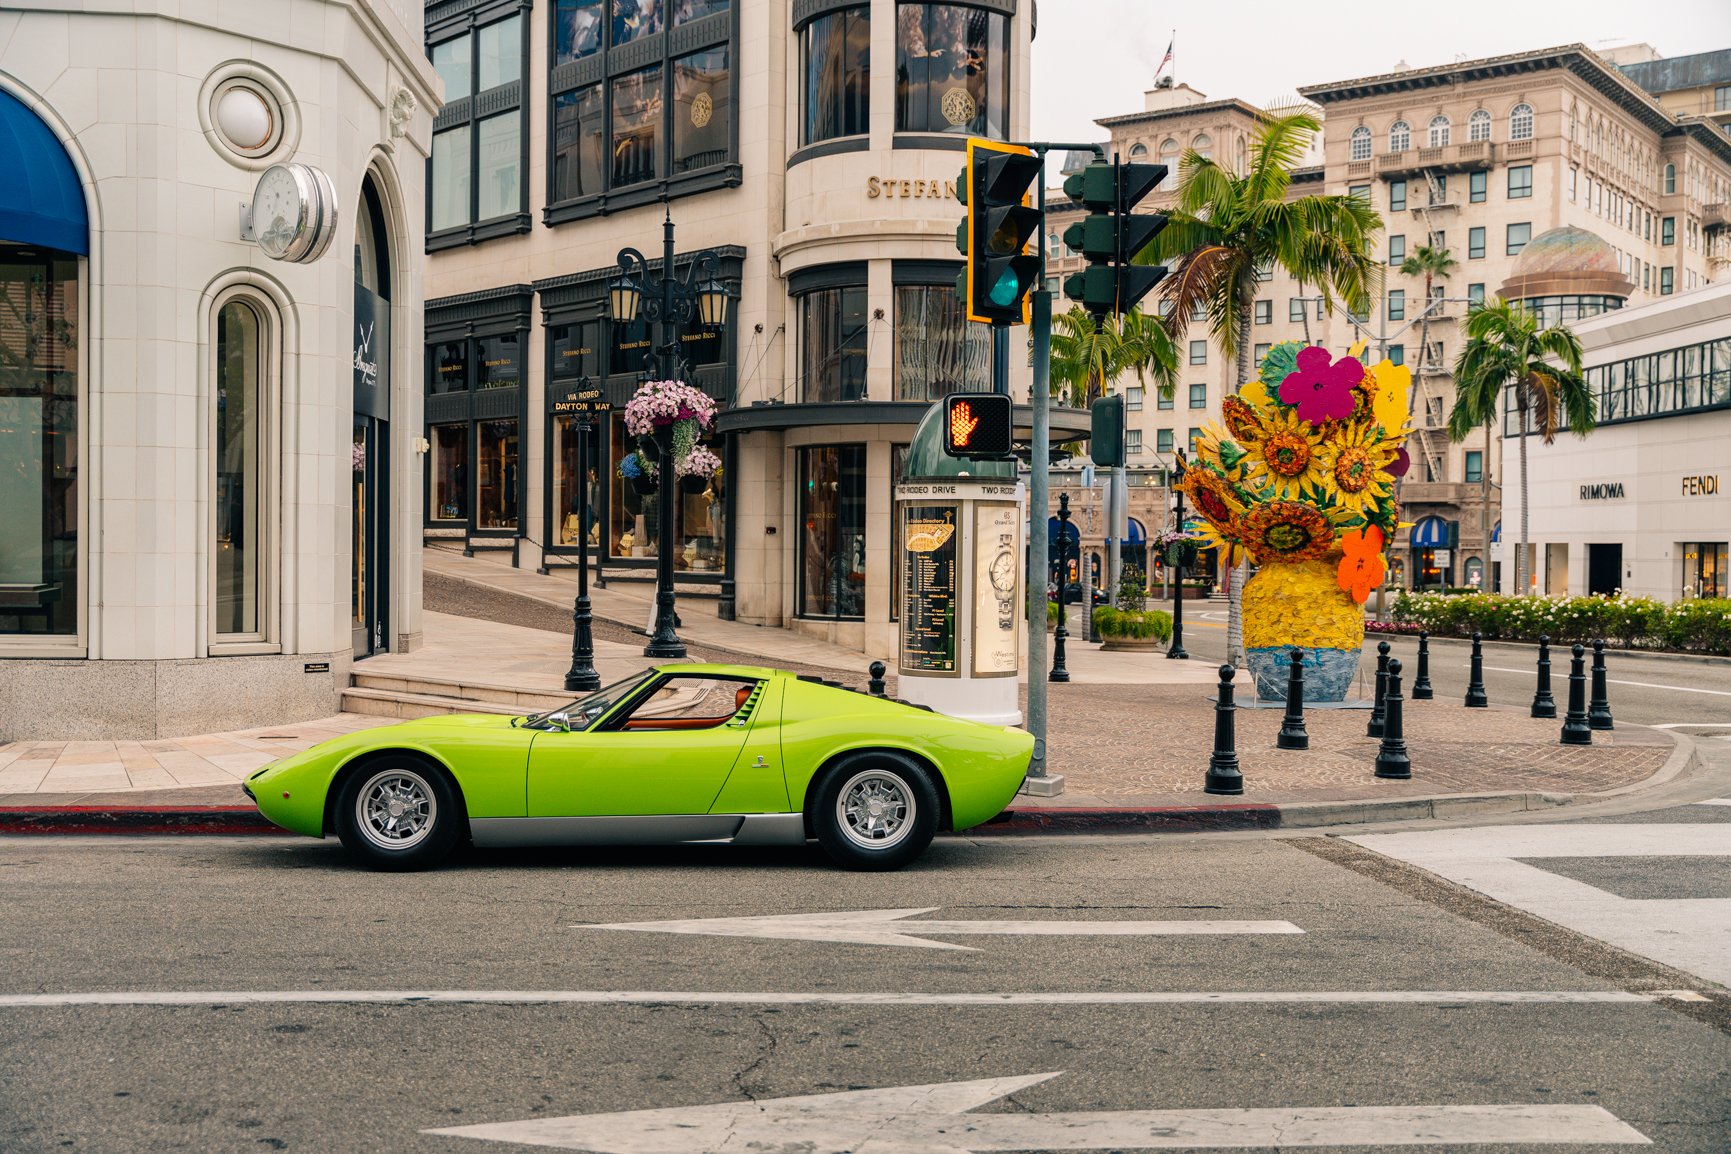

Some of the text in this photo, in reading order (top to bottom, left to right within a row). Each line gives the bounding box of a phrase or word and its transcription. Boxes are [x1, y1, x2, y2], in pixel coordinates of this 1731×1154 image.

[567, 390, 599, 401] VIA RODEO
[555, 402, 611, 411] DAYTON WAY
[932, 486, 956, 495] DRIVE
[981, 486, 999, 494] TWO
[1682, 475, 1720, 497] FENDI
[1580, 483, 1624, 500] RIMOWA
